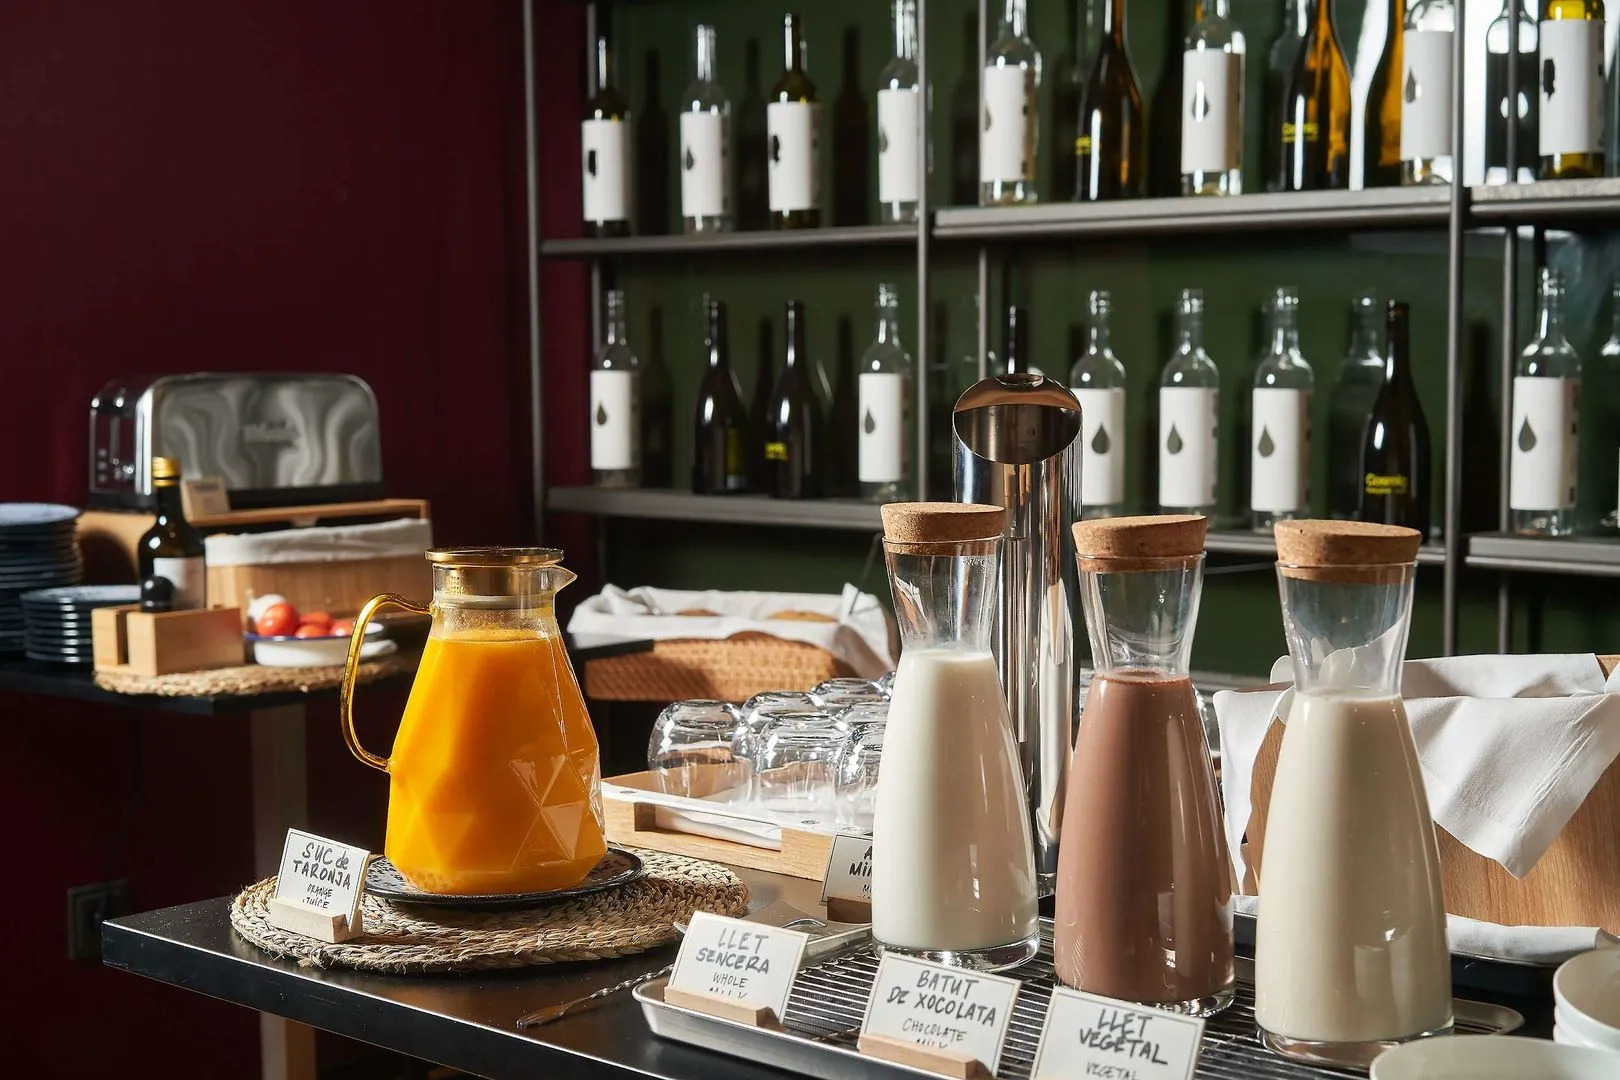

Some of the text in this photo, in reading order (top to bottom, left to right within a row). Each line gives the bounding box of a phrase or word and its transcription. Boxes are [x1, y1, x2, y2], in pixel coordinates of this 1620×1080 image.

[302, 842, 349, 871] SUC de
[293, 859, 351, 890] TARONJA
[307, 884, 333, 899] ORANGE
[717, 927, 769, 954] LLET
[696, 947, 770, 974] SENCERA
[712, 972, 748, 988] WHOLE
[916, 970, 979, 999] BATUT
[887, 986, 997, 1027] DE XOCOLATA
[902, 1018, 967, 1043] CHOCOLATE
[1097, 1008, 1152, 1038] LLET
[1079, 1028, 1168, 1065] VEGETAL
[1086, 1061, 1141, 1080] VEGETAL
